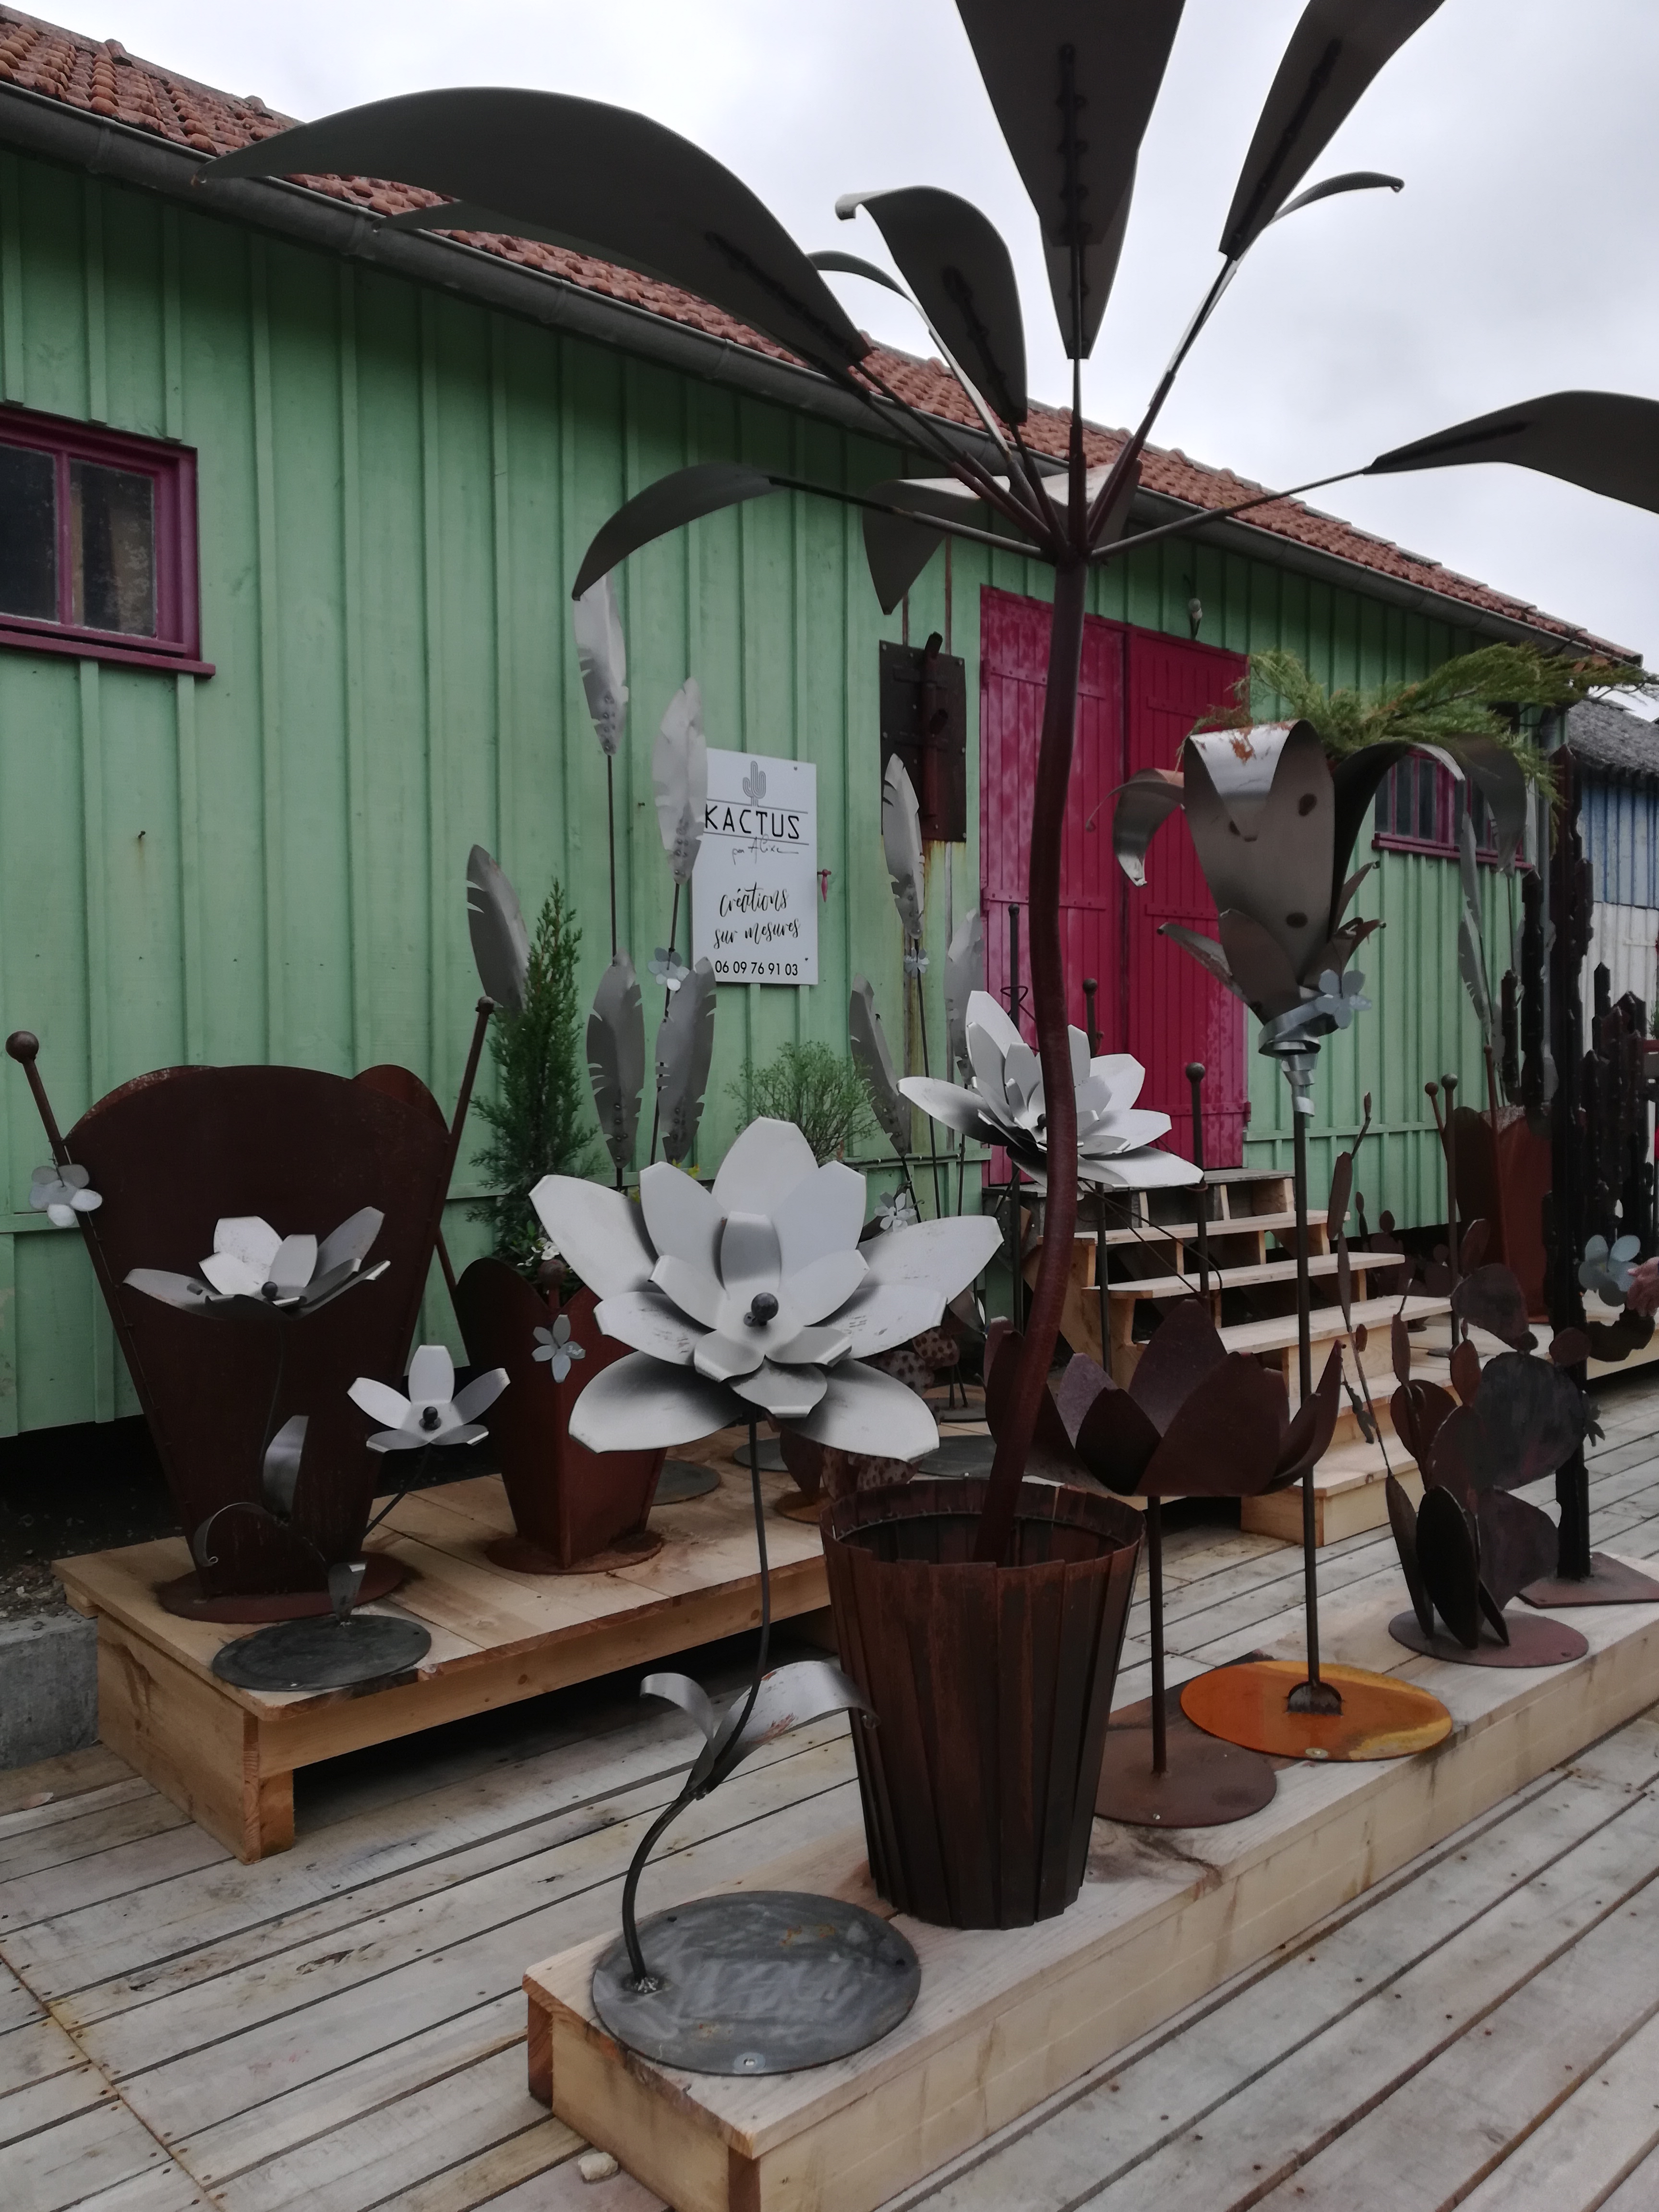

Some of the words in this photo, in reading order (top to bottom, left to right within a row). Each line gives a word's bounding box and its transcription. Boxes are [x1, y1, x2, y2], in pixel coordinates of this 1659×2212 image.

[705, 804, 799, 839] KACTUS
[720, 881, 789, 917] créations
[713, 928, 738, 950] sur
[745, 918, 801, 945] mesures
[715, 960, 729, 974] 06
[733, 961, 747, 974] 09
[751, 962, 764, 974] 76
[768, 962, 780, 975] 91
[785, 963, 798, 976] 03
